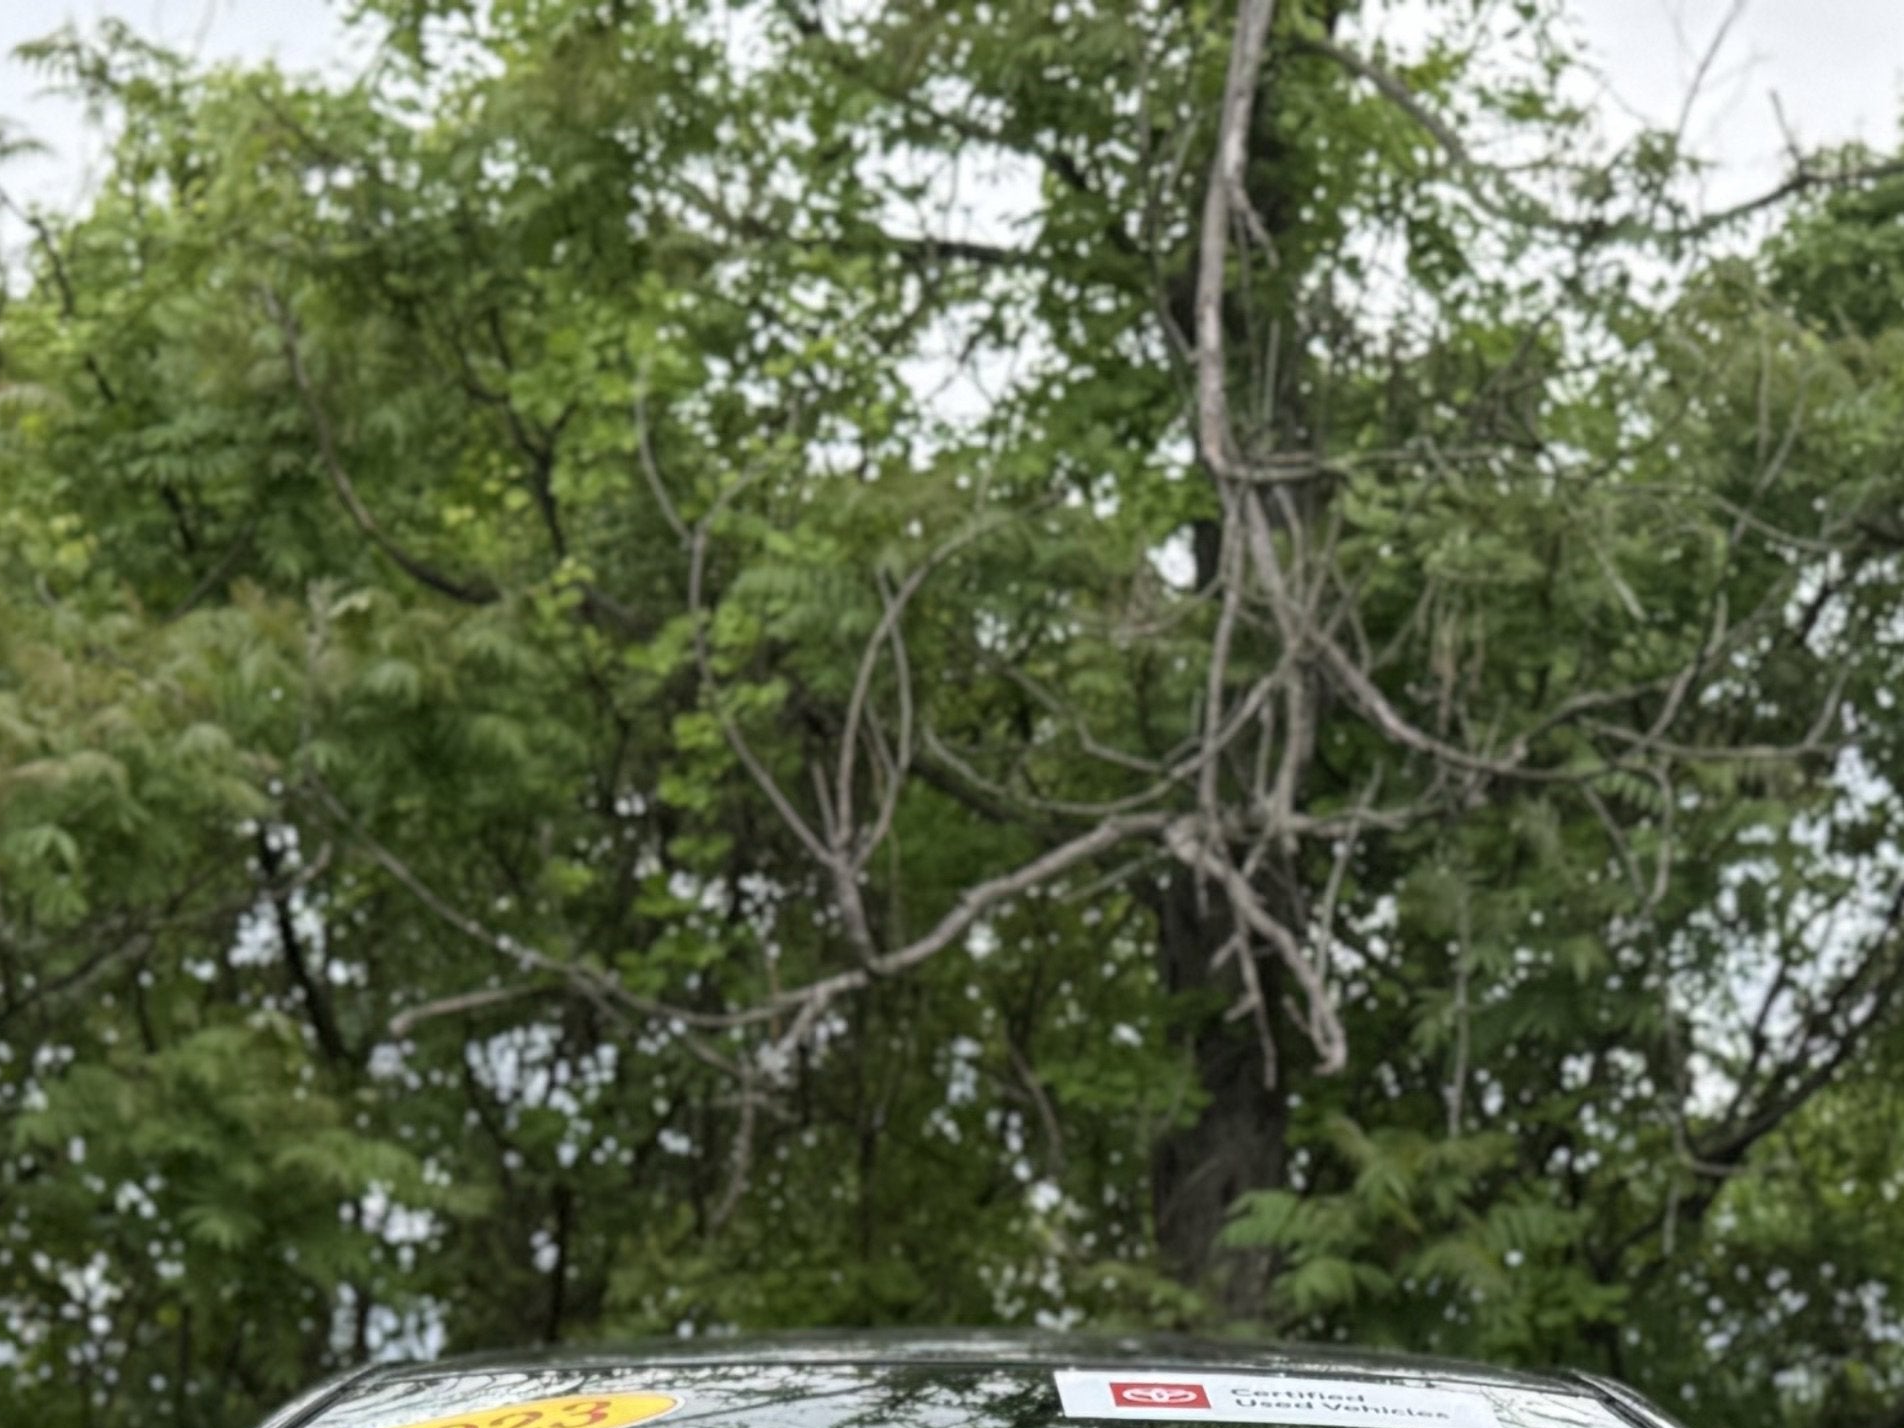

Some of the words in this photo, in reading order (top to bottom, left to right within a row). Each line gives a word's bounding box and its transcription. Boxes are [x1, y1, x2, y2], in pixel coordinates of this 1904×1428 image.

[1230, 1387, 1365, 1403] Certified
[1235, 1398, 1314, 1410] Used
[1321, 1402, 1450, 1420] Vehicles
